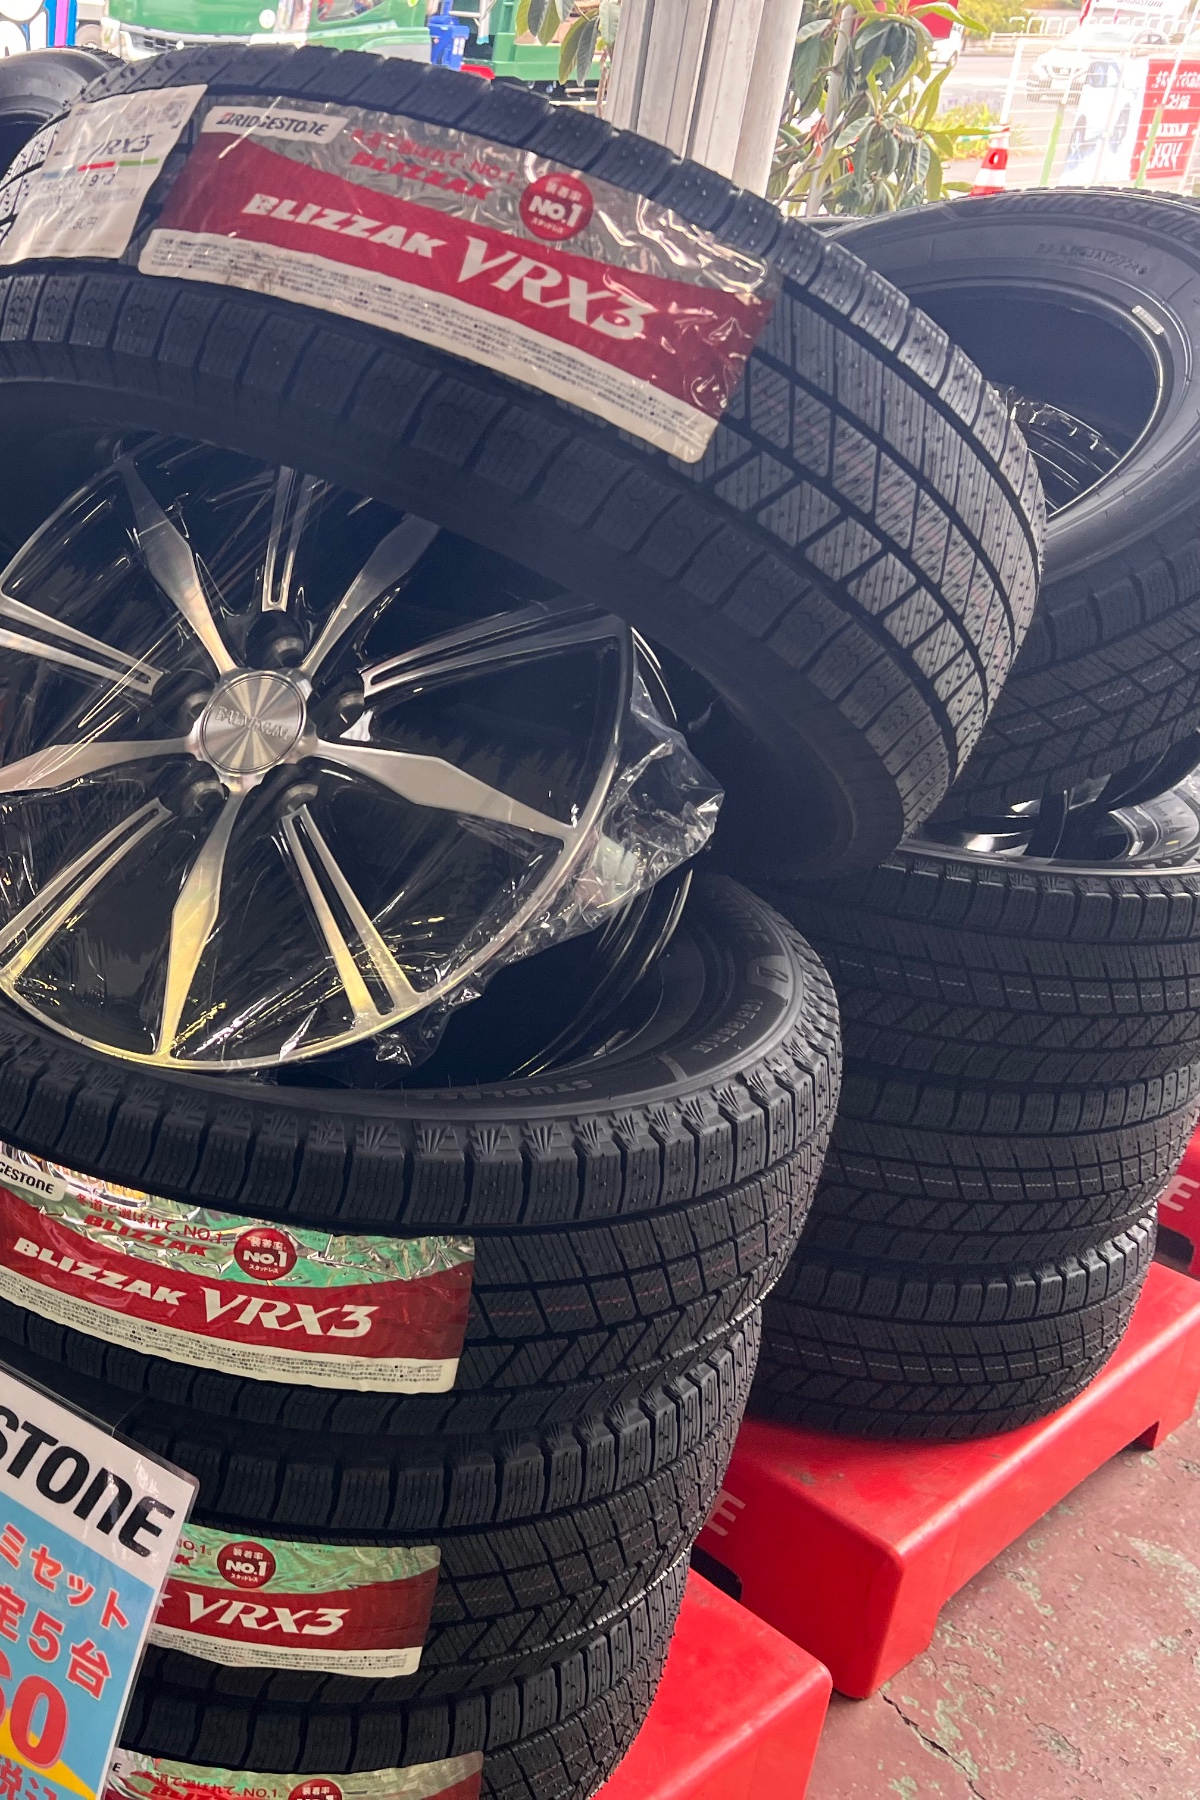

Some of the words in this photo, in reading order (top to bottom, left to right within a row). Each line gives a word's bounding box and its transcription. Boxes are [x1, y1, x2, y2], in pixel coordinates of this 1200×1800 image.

[217, 113, 329, 137] BRIDGESTONE
[350, 151, 496, 201] BLIZZAK
[528, 196, 583, 229] NO.1
[241, 193, 449, 259] BLIZZAK
[456, 235, 659, 341] VRX3
[83, 1214, 210, 1257] BLIZZAK
[242, 1250, 288, 1268] NO.1
[13, 1236, 188, 1307] BLIZZAK
[199, 1286, 381, 1338] VRX3
[225, 1559, 268, 1577] NO.1
[183, 1590, 351, 1636] VRX3
